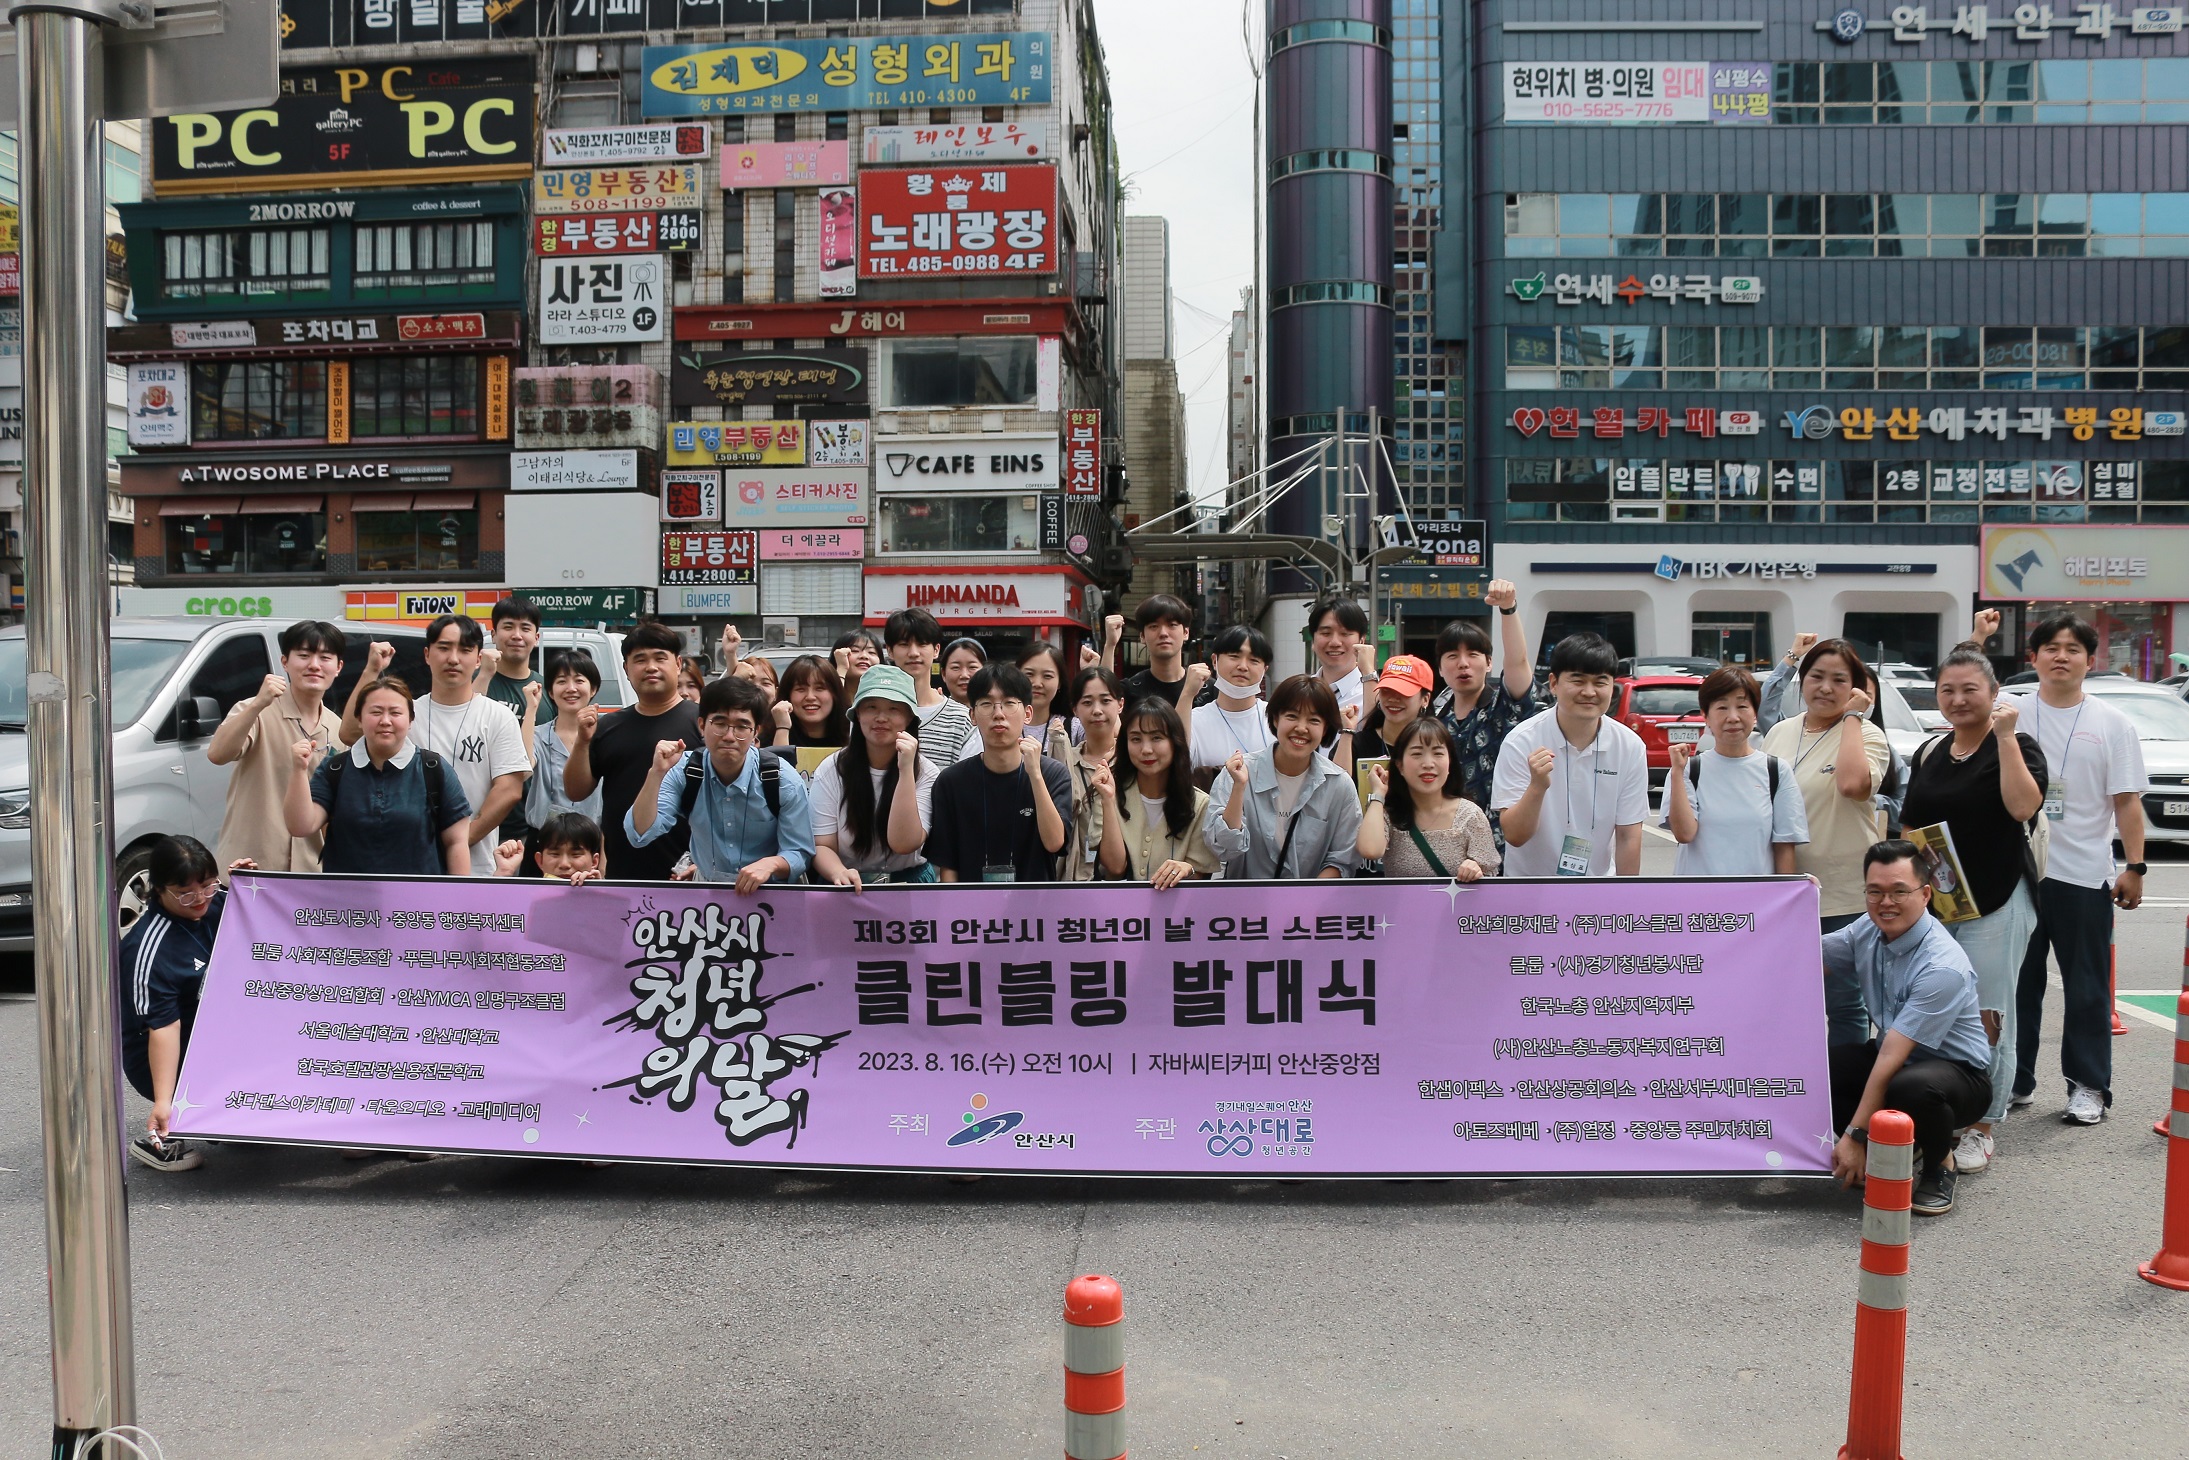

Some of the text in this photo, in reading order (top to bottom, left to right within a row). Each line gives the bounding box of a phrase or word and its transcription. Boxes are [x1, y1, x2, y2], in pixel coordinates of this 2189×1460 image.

[1891, 4, 2116, 41] 연세안과
[819, 40, 1016, 87] 성형외과
[1030, 41, 1044, 80] 의원
[335, 66, 416, 104] PC
[1512, 67, 1705, 98] 현위치 병·의원 임대
[1713, 68, 1769, 88] 실평수
[698, 93, 819, 112] 성형외과전문의
[868, 91, 890, 105] TEL
[1009, 87, 1031, 101] 4F
[1713, 93, 1769, 116] 44평
[1543, 102, 1673, 118] 010-5625-7776
[168, 109, 282, 170] PC
[399, 98, 517, 159] PC
[566, 129, 672, 148] 직화꼬치구이전문점
[913, 124, 1027, 148] 레인보우
[328, 143, 351, 161] 5F
[600, 146, 647, 158] T.405-9792
[542, 167, 679, 198] 민영부동산
[682, 168, 695, 193] 중개
[248, 200, 356, 222] 2MORROW
[412, 201, 437, 212] coffee
[446, 198, 481, 210] dessert
[540, 219, 558, 252] 한경
[561, 216, 652, 251] 부동산
[659, 226, 698, 240] 2800
[867, 208, 1047, 252] 노래광장
[1003, 252, 1046, 270] 4F
[547, 263, 623, 305] 사진
[1554, 272, 1712, 306] 연세수약국
[547, 307, 627, 323] 라라 스튜디오
[636, 312, 653, 326] 1F
[830, 310, 906, 335] J 헤어
[282, 319, 379, 343] 포차대교
[569, 324, 628, 336] T.403-4779
[137, 368, 177, 382] 포차대교
[1071, 413, 1098, 425] 한경
[1548, 406, 1717, 439] 헌혈카페
[1839, 405, 2143, 442] 안산예치과병원
[673, 424, 801, 452] 민영부동산
[516, 455, 565, 470] 그남자의
[621, 458, 632, 467] 6F
[714, 452, 763, 463] T.508-1199
[990, 453, 1044, 473] EINS
[1070, 426, 1096, 493] 부동산
[181, 467, 194, 482] A
[198, 464, 308, 482] TWOSOME
[315, 462, 390, 480] PLACE
[527, 471, 588, 485] 이태리식당
[597, 470, 629, 487] Lounge
[1615, 466, 1714, 493] 임플란트
[1773, 466, 1819, 493] 수면
[1885, 469, 1921, 493] 2층
[1932, 466, 2031, 494] 교정전문
[2093, 462, 2135, 481] 심미
[703, 482, 716, 517] 2층
[775, 482, 859, 501] 스티커사진
[1068, 493, 1099, 501] 414-2800
[2094, 480, 2136, 500] 보철
[1046, 501, 1058, 545] COFFEE
[1417, 523, 1463, 534] 아리조나
[668, 536, 682, 567] 한경
[683, 536, 750, 566] 부동산
[781, 534, 794, 548] 더
[852, 549, 861, 558] 3F
[668, 568, 737, 583] 414-2800
[1691, 558, 1818, 580] IBK 기업은행
[2063, 556, 2148, 578] 해리포토
[686, 592, 732, 608] BUMPER
[906, 585, 1020, 608] HIMNANDA
[1391, 583, 1480, 598] 신세기빌딩
[185, 597, 273, 617] crocs
[602, 594, 626, 611] 4F
[1386, 662, 1413, 674] Hawaii
[458, 734, 485, 764] NY
[294, 908, 382, 928] 안산도시공사
[438, 911, 526, 933] 행정복지센터
[853, 915, 1376, 945] 제3회 안산시 청년의 날 오브 스트릿
[1457, 913, 1559, 936] 안산희망재단
[1686, 911, 1756, 934] 친한용기
[251, 942, 283, 962] 필룸
[285, 946, 393, 968] 사회적협동조합
[1509, 955, 1545, 977] 클룹
[244, 979, 386, 1006] 안산중앙상인연합회
[474, 990, 567, 1012] 인명구조클럽
[854, 957, 1377, 1028] 클린블링 발대식
[1520, 995, 1695, 1017] 한국노총 안산지역지부
[298, 1020, 410, 1044] 서울예술대학교
[1492, 1036, 1725, 1060] (사)안산노총노동자복지연구회
[297, 1058, 485, 1081] 한국호텔관광실용전문학교
[858, 1051, 1381, 1076] 2023. 8. 16.(수) 오전 10시 자바씨티커피 안산중앙점
[1417, 1079, 1504, 1100] 한샘이펙스
[225, 1090, 355, 1116] 샷다댄스아카데미
[1215, 1098, 1314, 1113] 경기내일스퀘어 안산
[887, 1112, 930, 1137] 주최
[1134, 1116, 1178, 1140] 주관
[1453, 1121, 1540, 1141] 아토즈베베
[1684, 1119, 1773, 1140] 주민자치회
[1013, 1131, 1076, 1151] 안산시
[1197, 1115, 1317, 1158] 상상대로
[1260, 1144, 1313, 1157] 청년공간
